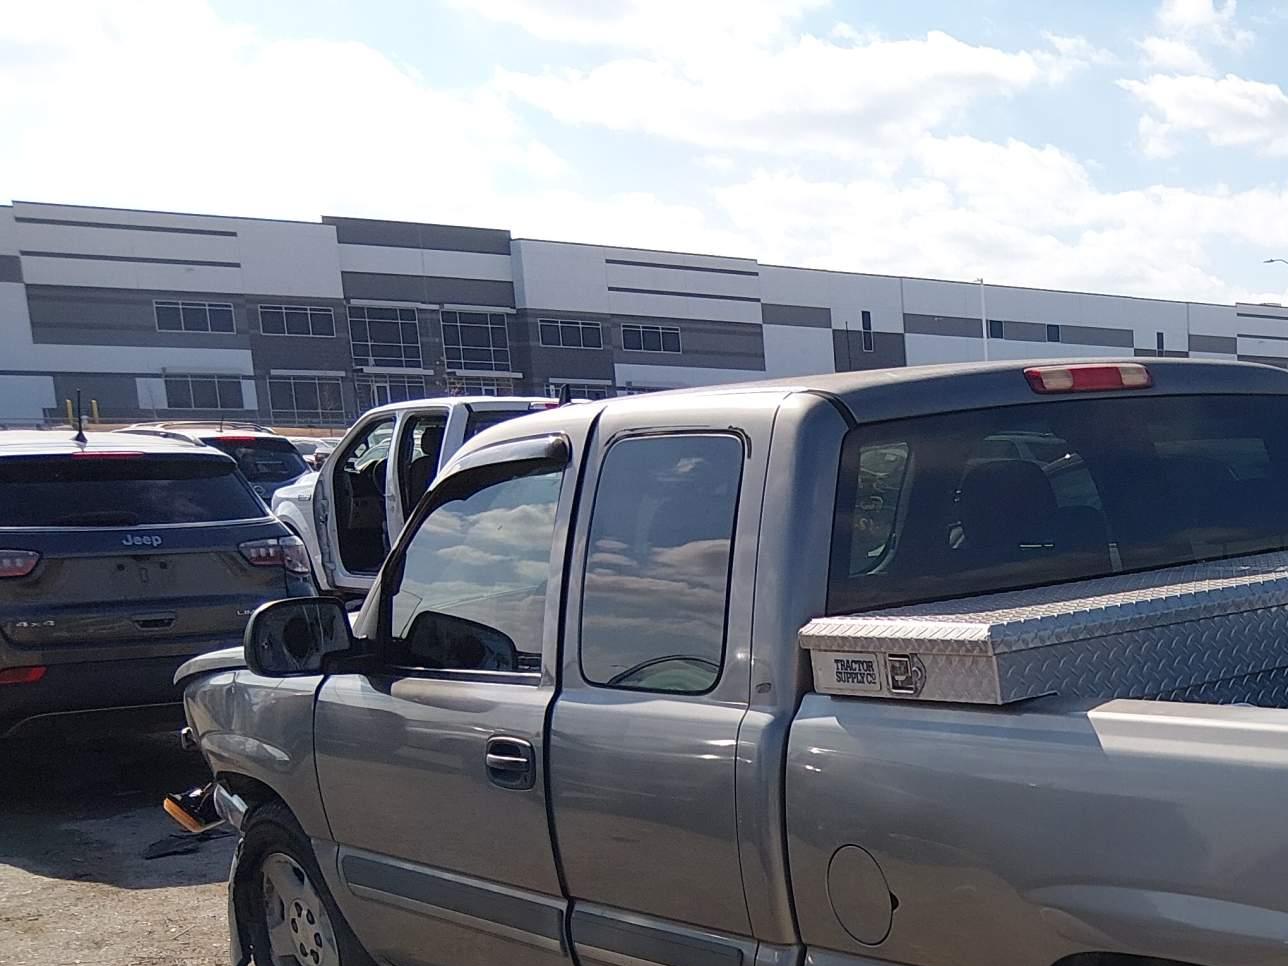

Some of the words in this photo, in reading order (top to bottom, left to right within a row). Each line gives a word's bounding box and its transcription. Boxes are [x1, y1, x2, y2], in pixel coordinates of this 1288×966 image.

[122, 534, 162, 547] Jeep
[834, 659, 875, 672] TRACTOR
[836, 672, 866, 684] SUPPLY
